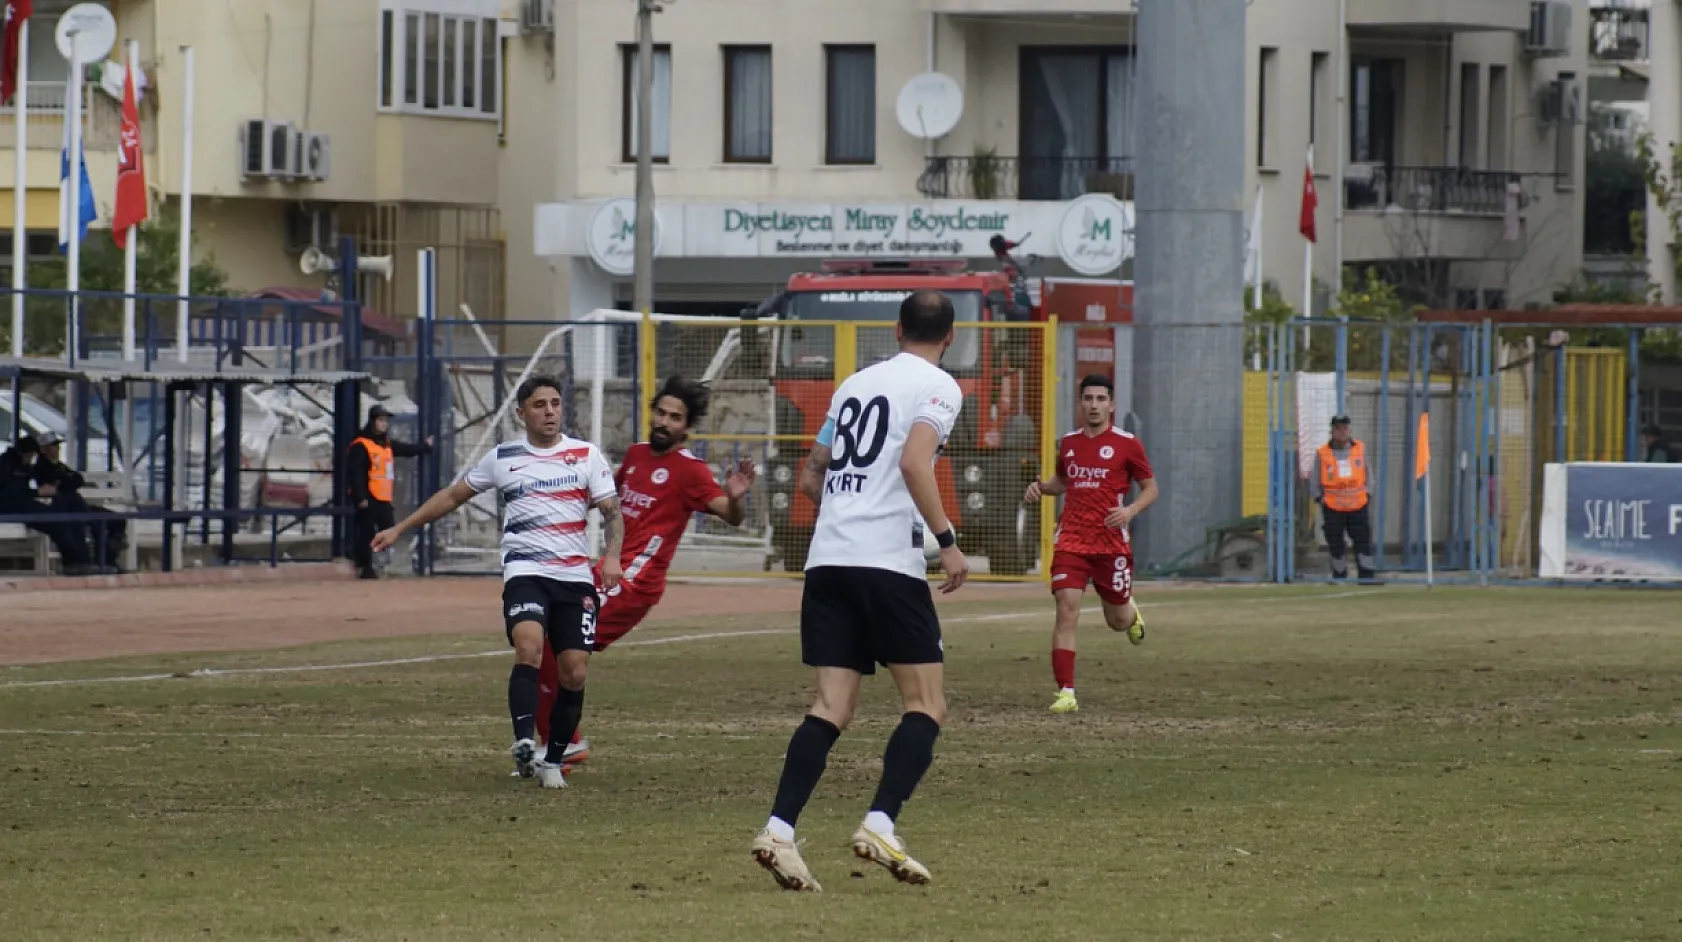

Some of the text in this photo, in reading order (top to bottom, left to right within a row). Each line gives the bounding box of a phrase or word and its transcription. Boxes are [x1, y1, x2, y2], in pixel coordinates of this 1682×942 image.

[724, 206, 1009, 238] Diyetisyen Miray Soydemir
[828, 394, 890, 471] 80
[1111, 567, 1131, 593] 55
